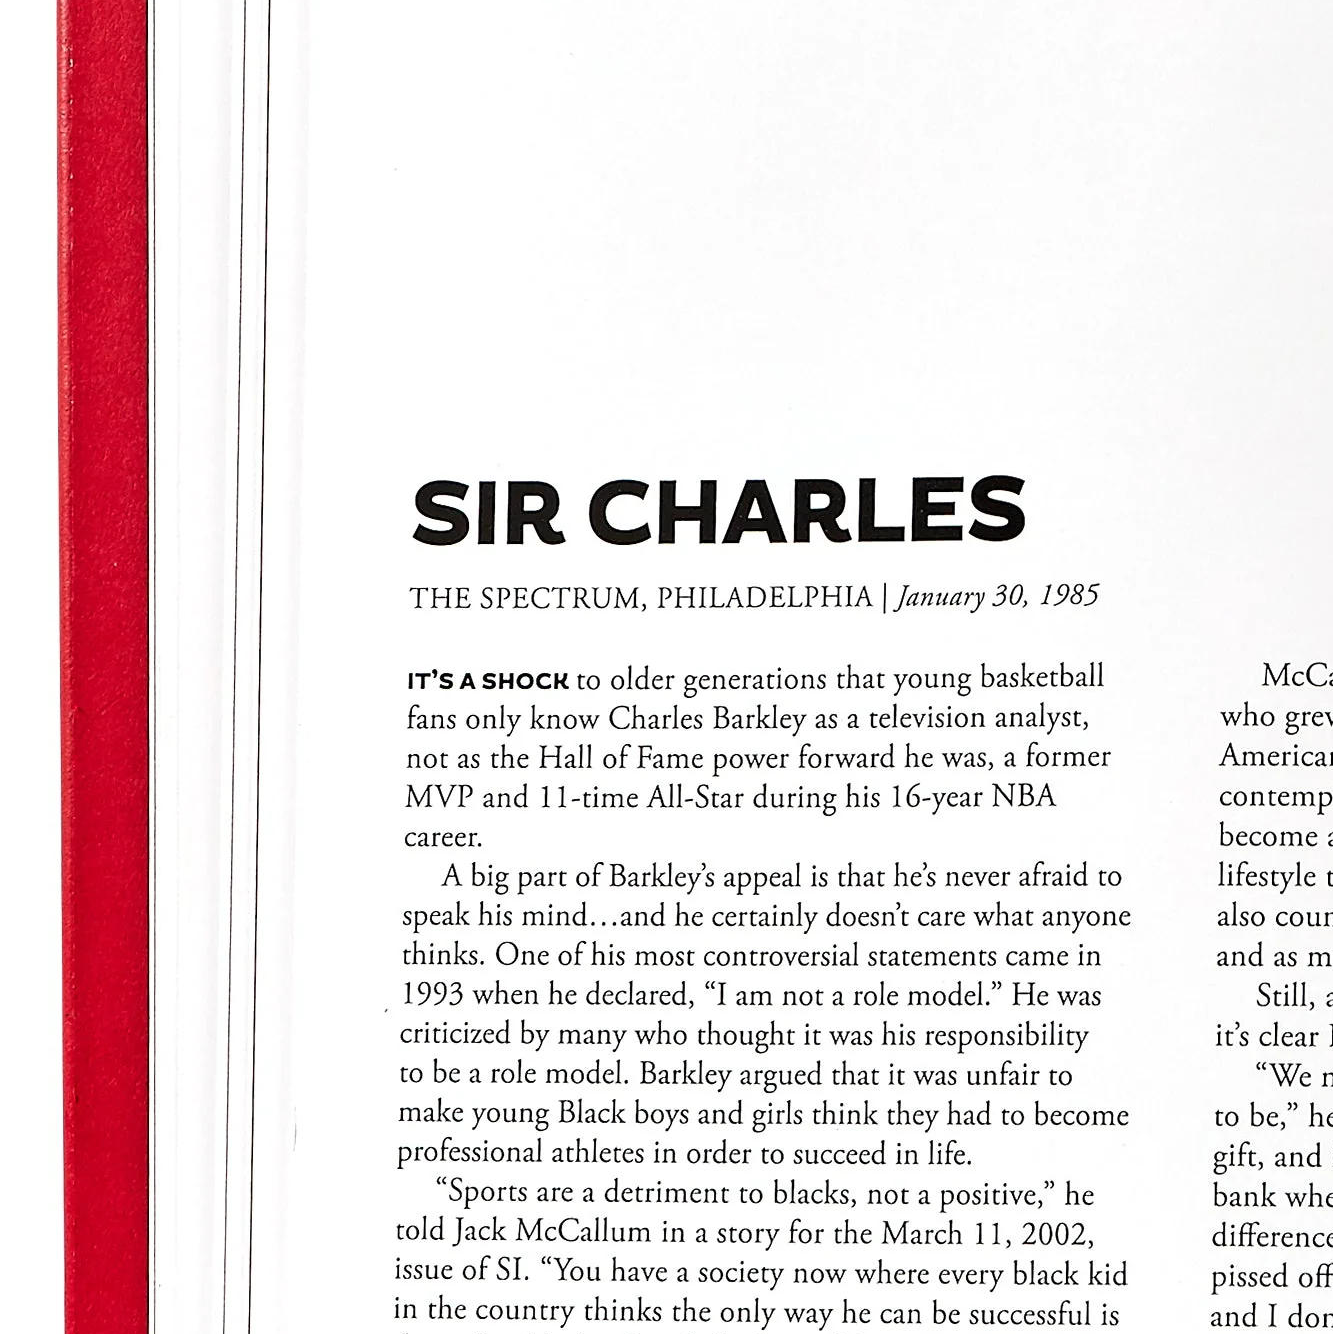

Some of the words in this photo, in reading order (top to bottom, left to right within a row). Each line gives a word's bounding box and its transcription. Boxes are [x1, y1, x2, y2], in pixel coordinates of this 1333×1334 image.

[411, 479, 567, 547] SIR
[588, 474, 1026, 546] CHARLES
[408, 586, 472, 609] THE
[480, 586, 647, 613] SPECTRUM,
[657, 585, 874, 609] PHILADELPHIA
[892, 584, 986, 614] January
[991, 583, 1028, 609] 30,
[1040, 582, 1101, 607] 1985
[459, 672, 477, 690] A
[481, 672, 570, 690] SHOCK
[576, 673, 601, 691] to
[610, 664, 676, 691] older
[683, 666, 827, 699] generations
[836, 663, 886, 690] that
[892, 672, 972, 698] young
[980, 661, 1105, 688] basketball
[404, 783, 474, 808] MVP
[482, 782, 529, 809] and
[541, 785, 639, 809] 11-time
[645, 782, 745, 809] All-Star
[752, 782, 838, 817] during
[845, 782, 881, 808] his
[892, 782, 984, 816] 16-year
[991, 782, 1057, 808] NBA
[1217, 900, 1266, 927] also
[402, 939, 485, 966] thinks.
[495, 941, 550, 966] One
[557, 940, 587, 967] of
[590, 940, 626, 967] his
[634, 949, 696, 967] most
[703, 940, 859, 967] controversial
[867, 949, 998, 967] statements
[1005, 950, 1069, 967] came
[1077, 943, 1102, 967] in
[397, 1096, 464, 1123] make
[471, 1107, 550, 1132] young
[558, 1098, 627, 1124] Black
[634, 1098, 690, 1132] boys
[697, 1099, 744, 1125] and
[751, 1099, 803, 1134] girls
[812, 1099, 879, 1126] think
[887, 1099, 940, 1134] they
[946, 1099, 992, 1126] had
[1001, 1108, 1025, 1126] to
[1034, 1100, 1130, 1127] become
[396, 1214, 446, 1241] told
[451, 1215, 508, 1248] Jack
[515, 1216, 652, 1243] McCallum
[661, 1220, 686, 1243] in
[695, 1227, 709, 1244] a
[716, 1226, 781, 1252] story
[788, 1217, 825, 1245] for
[833, 1218, 873, 1245] the
[881, 1219, 963, 1245] March
[975, 1222, 1012, 1250] 11,
[1021, 1221, 1094, 1250] 2002,
